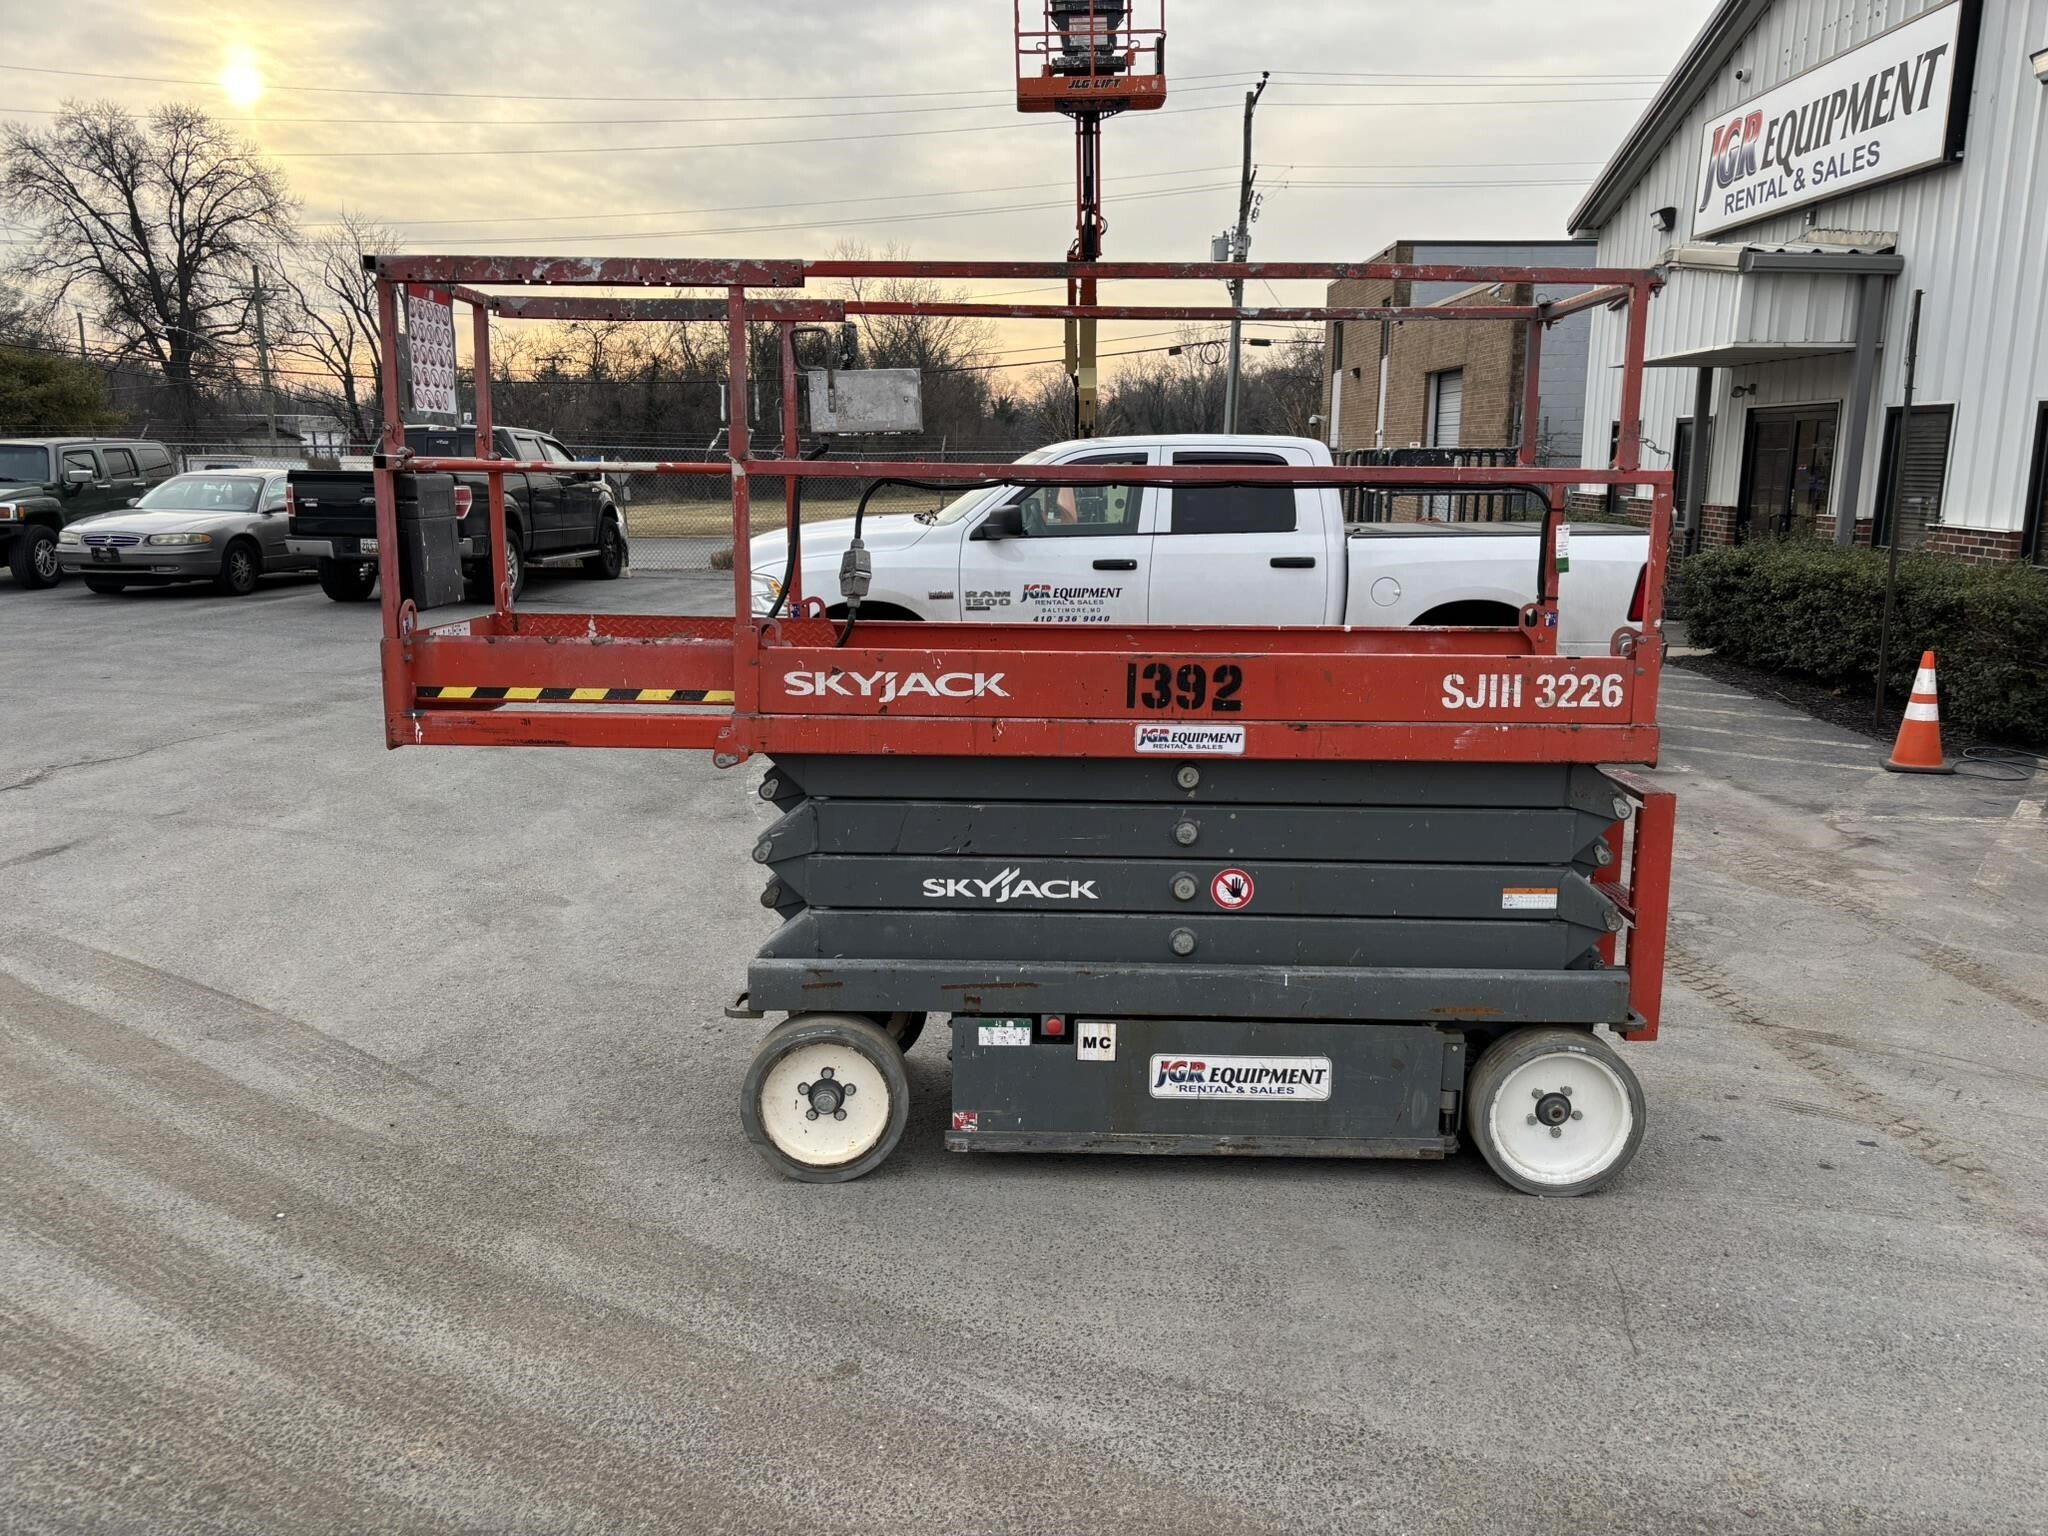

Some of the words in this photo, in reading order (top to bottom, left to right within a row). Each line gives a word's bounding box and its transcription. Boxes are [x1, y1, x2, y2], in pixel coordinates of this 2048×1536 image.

[1068, 79, 1091, 88] JLG
[1094, 79, 1120, 88] LIFT
[1699, 110, 1763, 213] JGR
[1760, 43, 1949, 177] EQUIPMENT
[1724, 175, 1788, 216] RENTAL
[1793, 167, 1806, 191] &
[1811, 140, 1881, 185] SALES
[965, 598, 1011, 606] 1500
[1020, 584, 1051, 603] JGR
[1053, 587, 1123, 602] EQUIPMENT
[783, 671, 1011, 703] SKYJACK
[1126, 662, 1243, 712] 1392
[1534, 673, 1624, 708] 3226
[1138, 728, 1169, 746] JGR
[1171, 732, 1242, 745] EQUIPMENT
[922, 867, 1099, 903] SKYJACK
[1082, 1036, 1111, 1049] MC
[1154, 1060, 1207, 1087] JGR
[1209, 1067, 1327, 1088] EQUIPMENT
[1178, 1084, 1232, 1094] RENTAL
[1235, 1086, 1245, 1094] &
[1249, 1086, 1295, 1094] SALES
